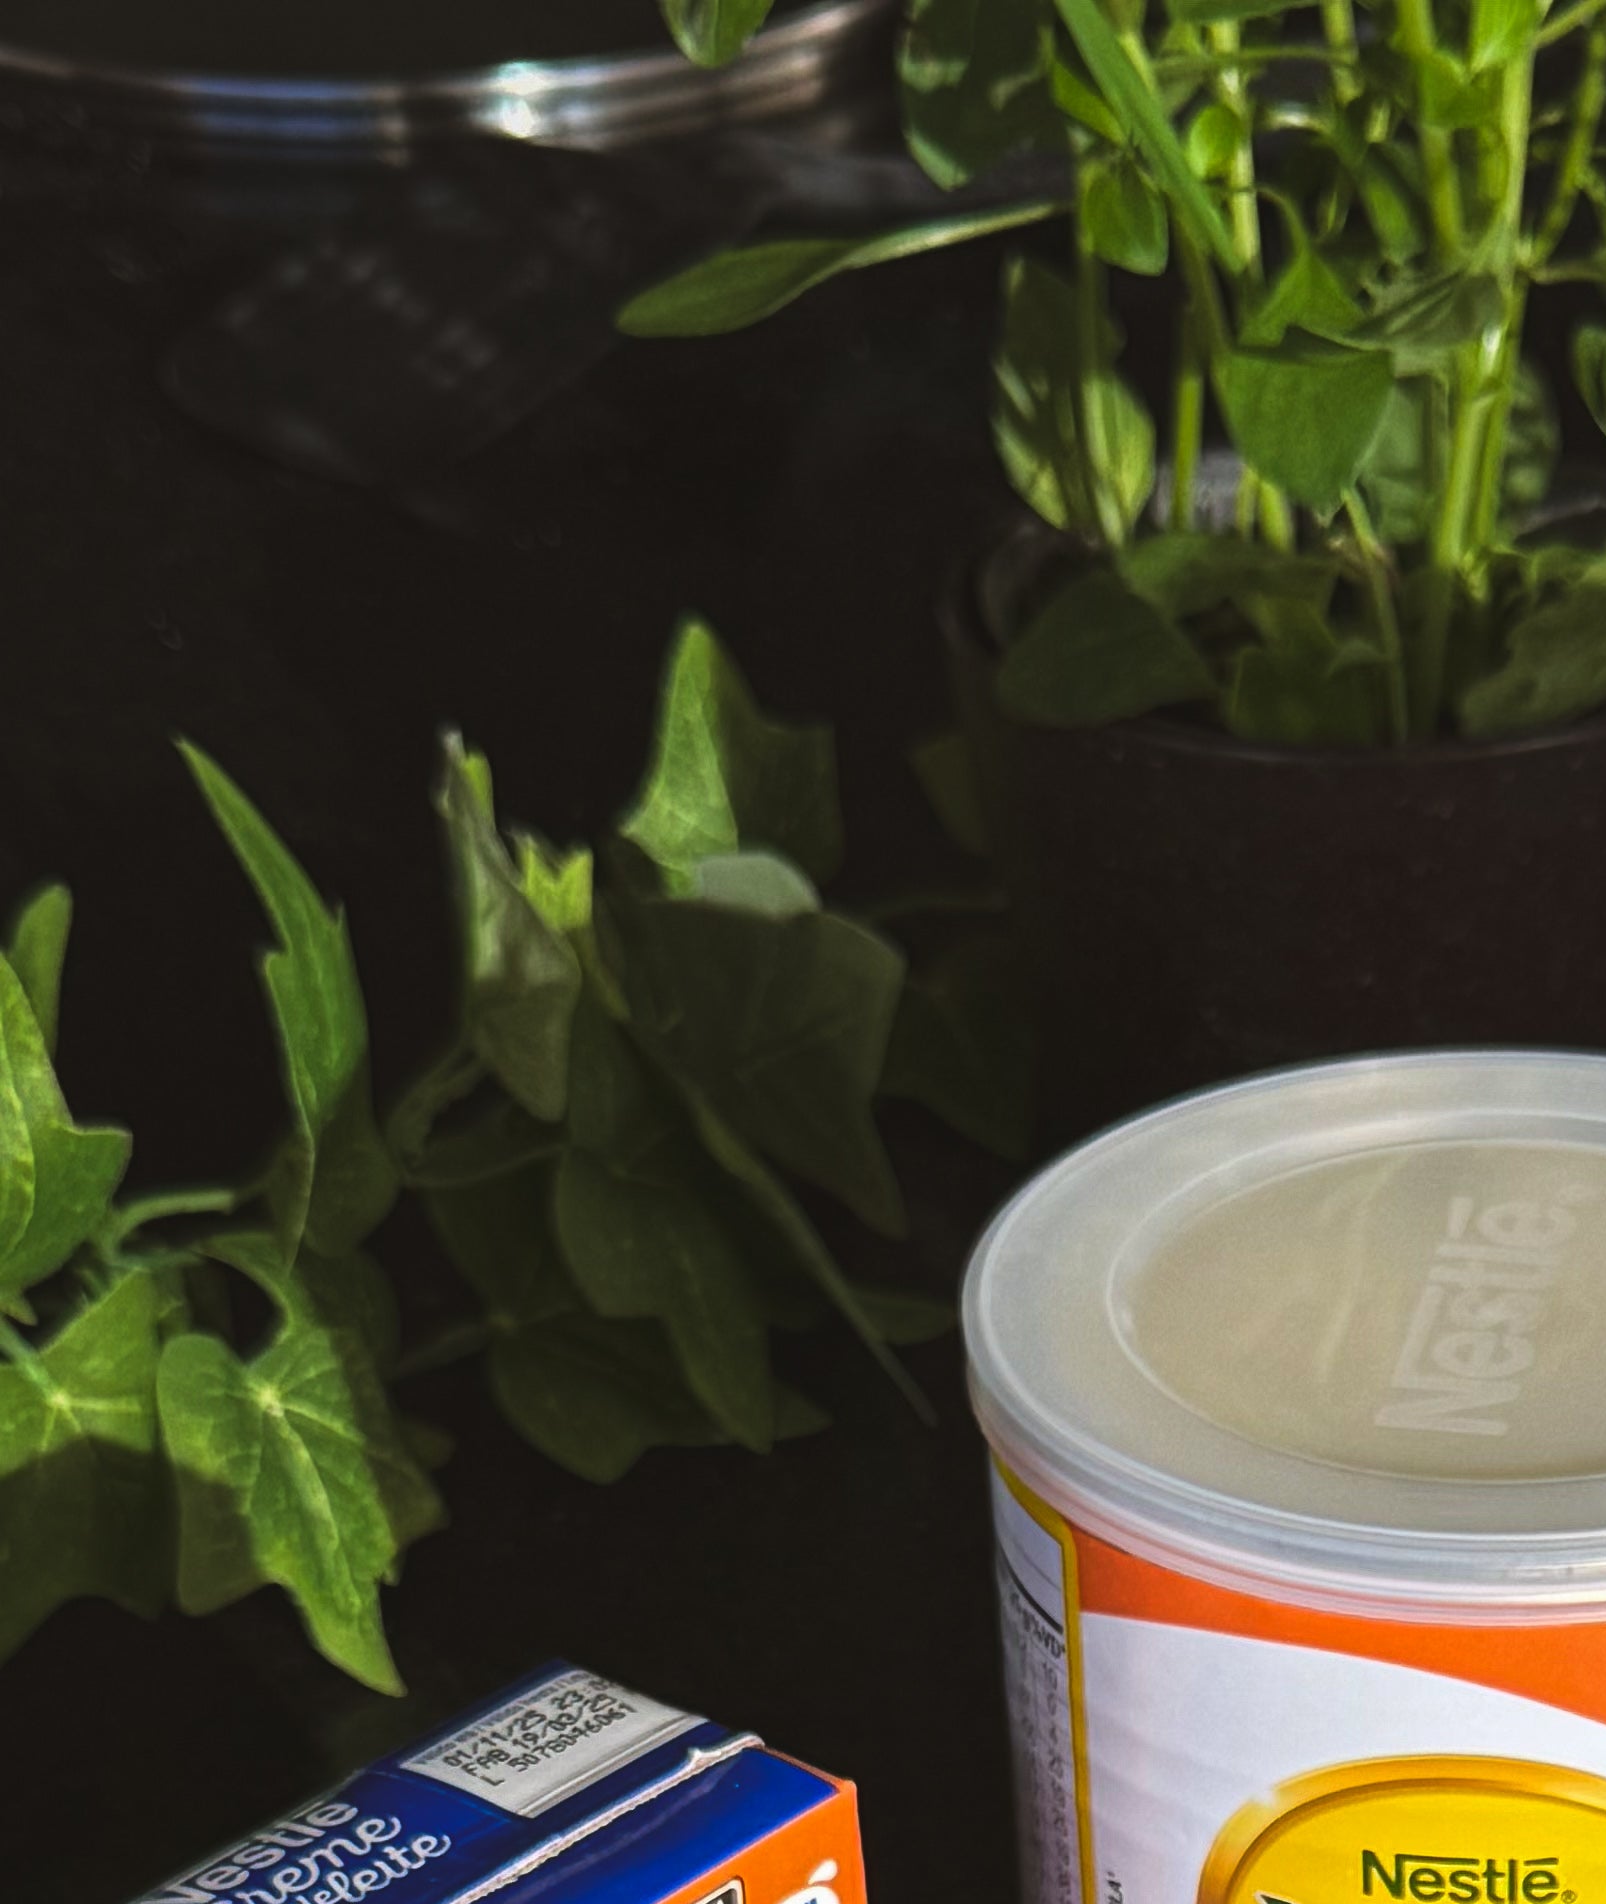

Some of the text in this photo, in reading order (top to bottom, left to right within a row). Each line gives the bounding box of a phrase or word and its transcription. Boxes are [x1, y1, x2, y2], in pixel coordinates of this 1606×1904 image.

[1374, 1196, 1578, 1436] Nestlé
[444, 1709, 547, 1767] 01/11/25
[464, 1748, 504, 1778] FAB
[480, 1774, 505, 1788] L
[1362, 1849, 1560, 1904] Nestlé
